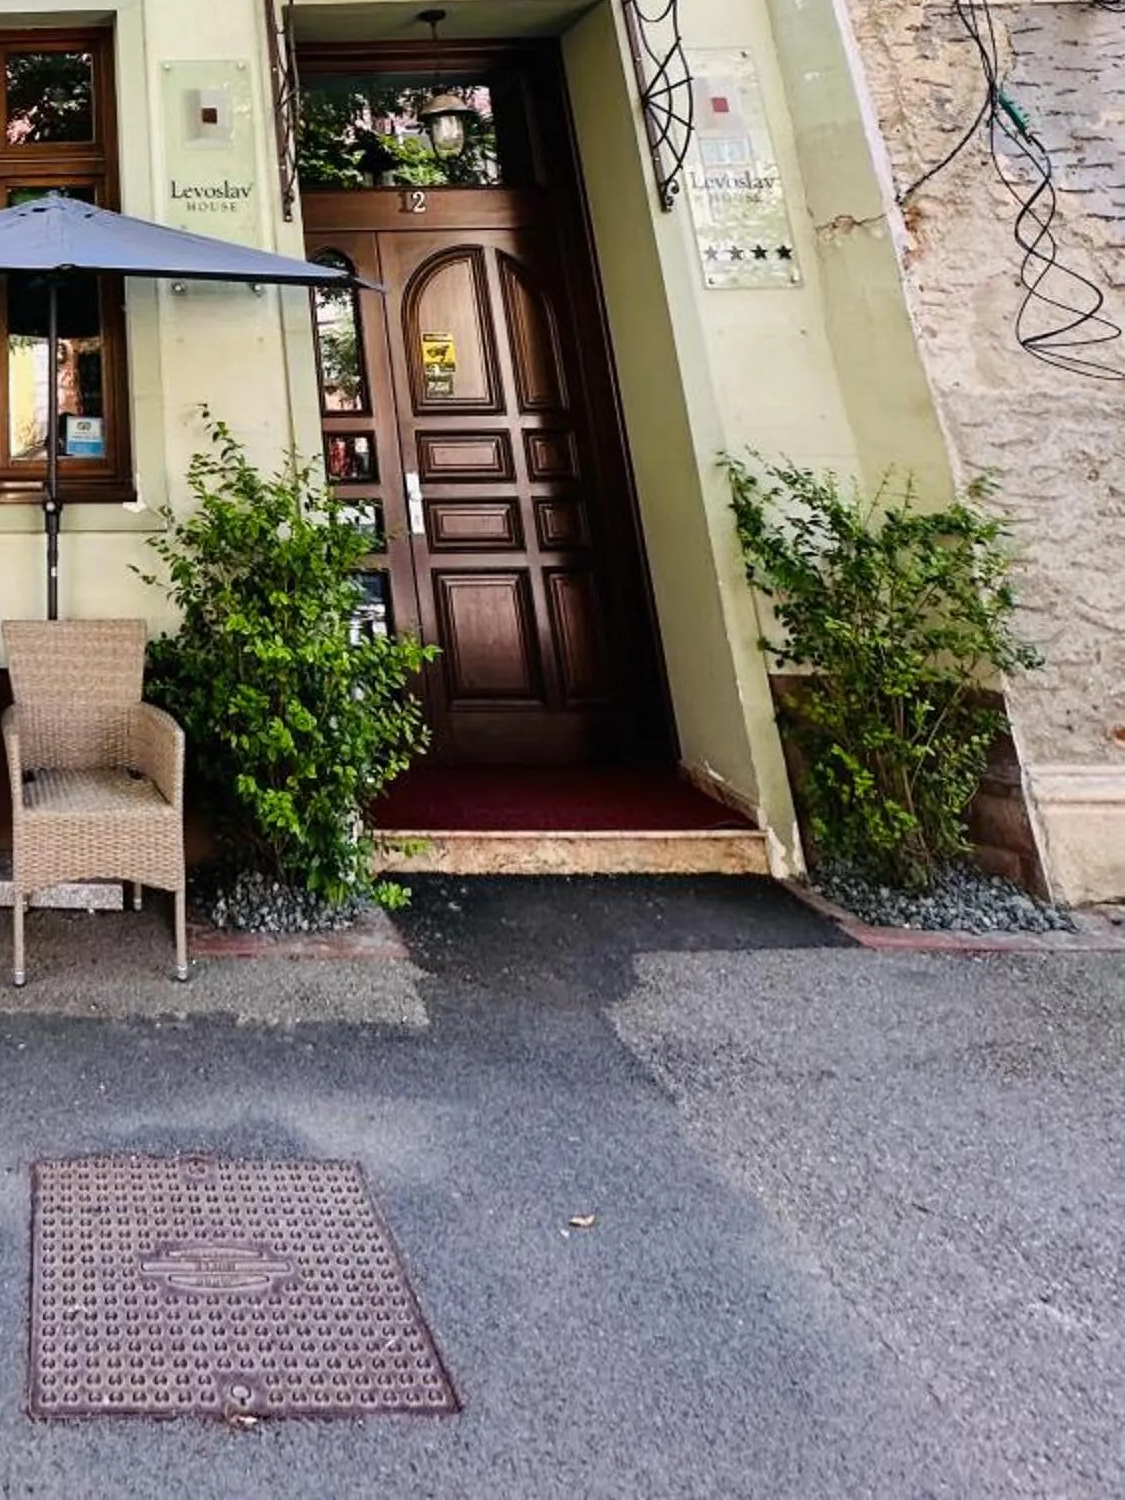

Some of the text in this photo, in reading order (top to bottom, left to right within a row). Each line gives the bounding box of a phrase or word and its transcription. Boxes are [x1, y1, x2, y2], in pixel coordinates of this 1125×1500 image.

[170, 179, 253, 199] Levoslav
[690, 171, 778, 189] Levoslav
[186, 201, 238, 213] HOUSE
[398, 190, 427, 214] 12
